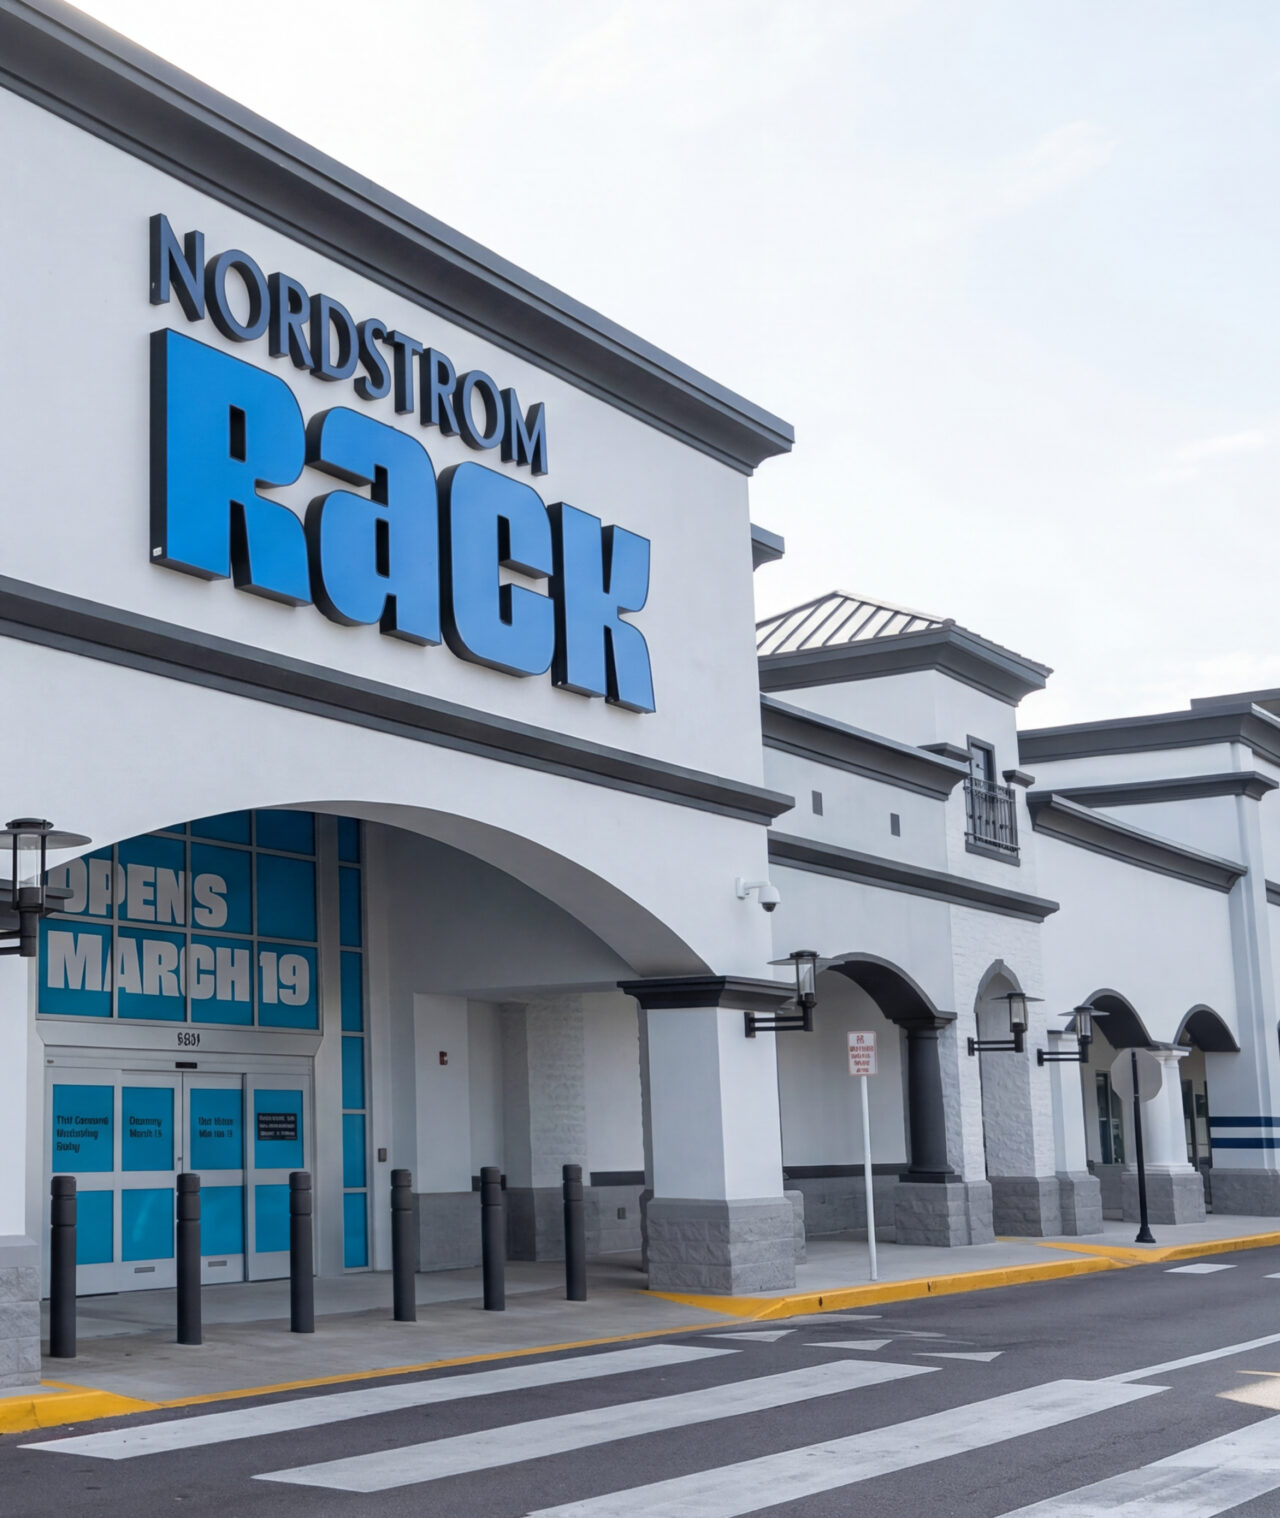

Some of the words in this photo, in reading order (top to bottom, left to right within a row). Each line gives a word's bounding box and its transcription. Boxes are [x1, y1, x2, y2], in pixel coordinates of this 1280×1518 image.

[150, 213, 548, 476] NORDSTROM
[47, 857, 228, 928] OPENS
[47, 930, 251, 1002] MARCH
[259, 951, 310, 1006] 19
